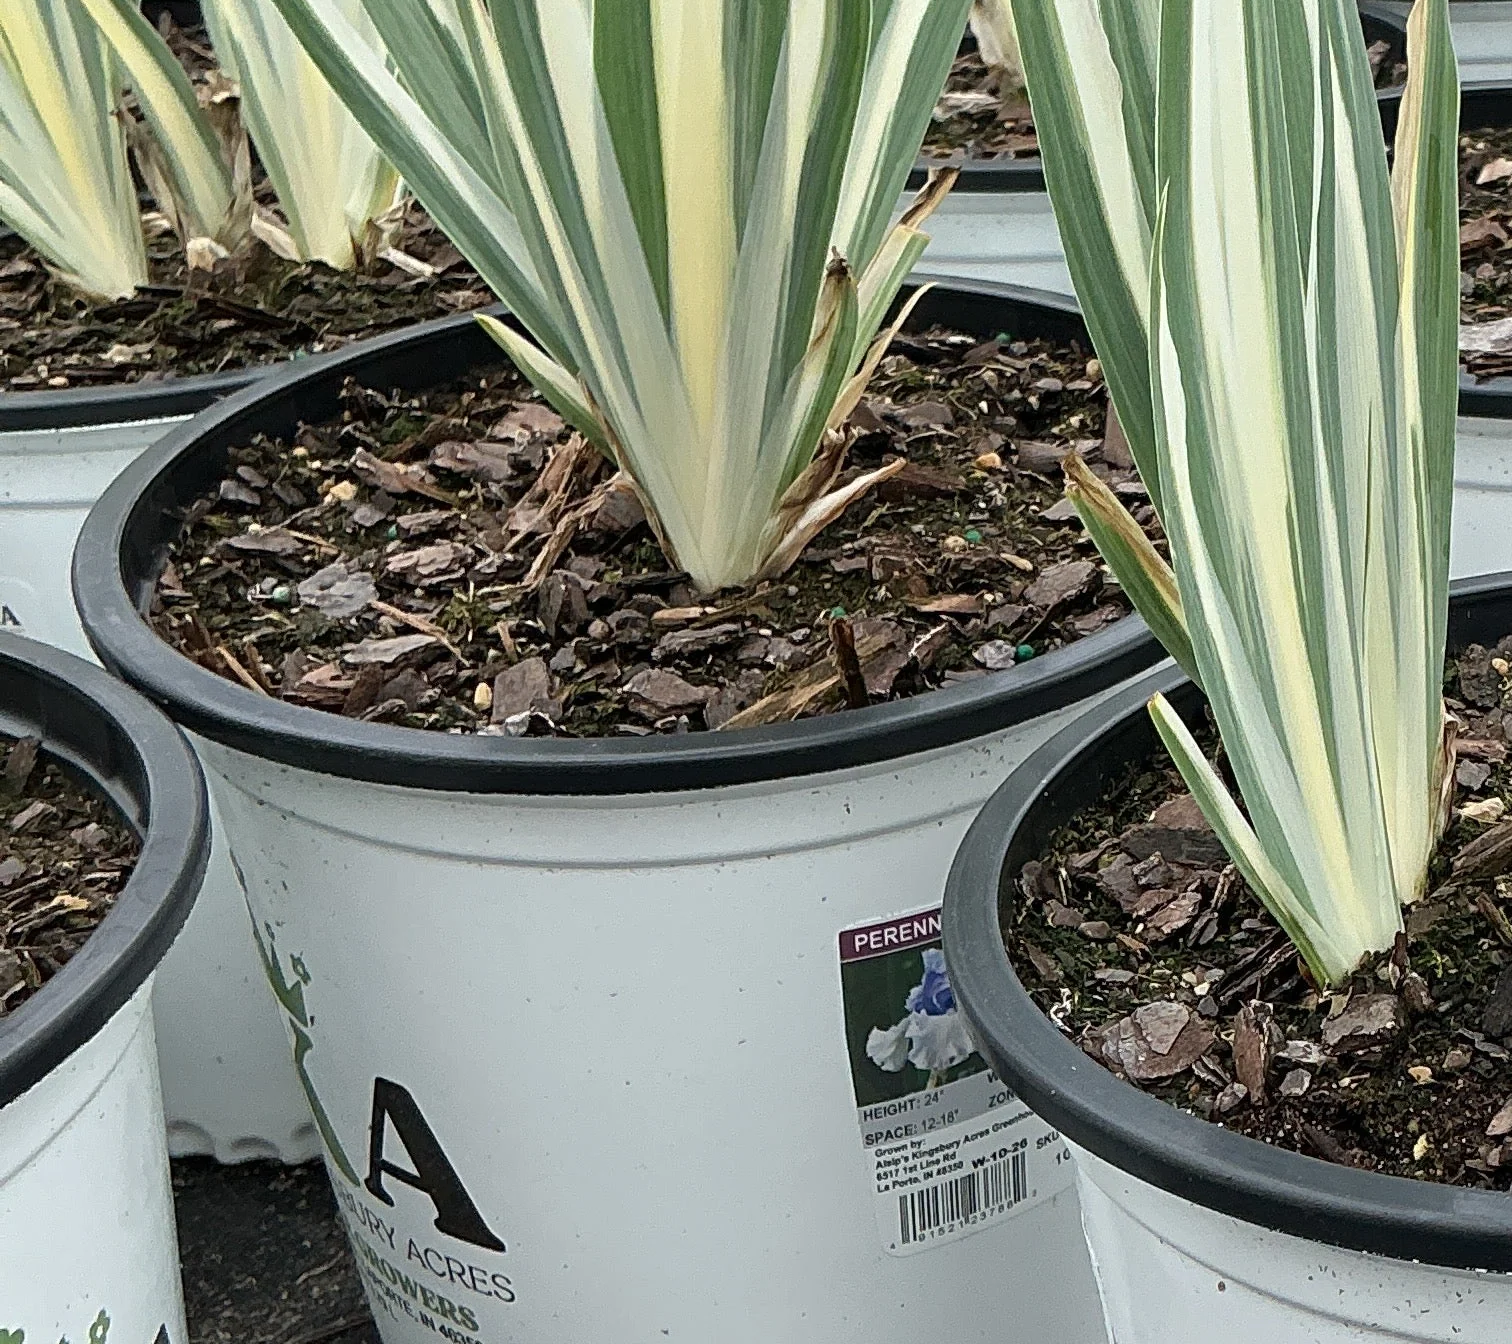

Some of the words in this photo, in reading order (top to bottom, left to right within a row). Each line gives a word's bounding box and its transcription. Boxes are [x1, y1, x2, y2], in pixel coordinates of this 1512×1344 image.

[863, 1098, 922, 1122] HEIGHT:
[864, 1123, 919, 1147] SPACE:
[874, 1142, 909, 1158] Grown
[406, 1237, 516, 1303] ACRES
